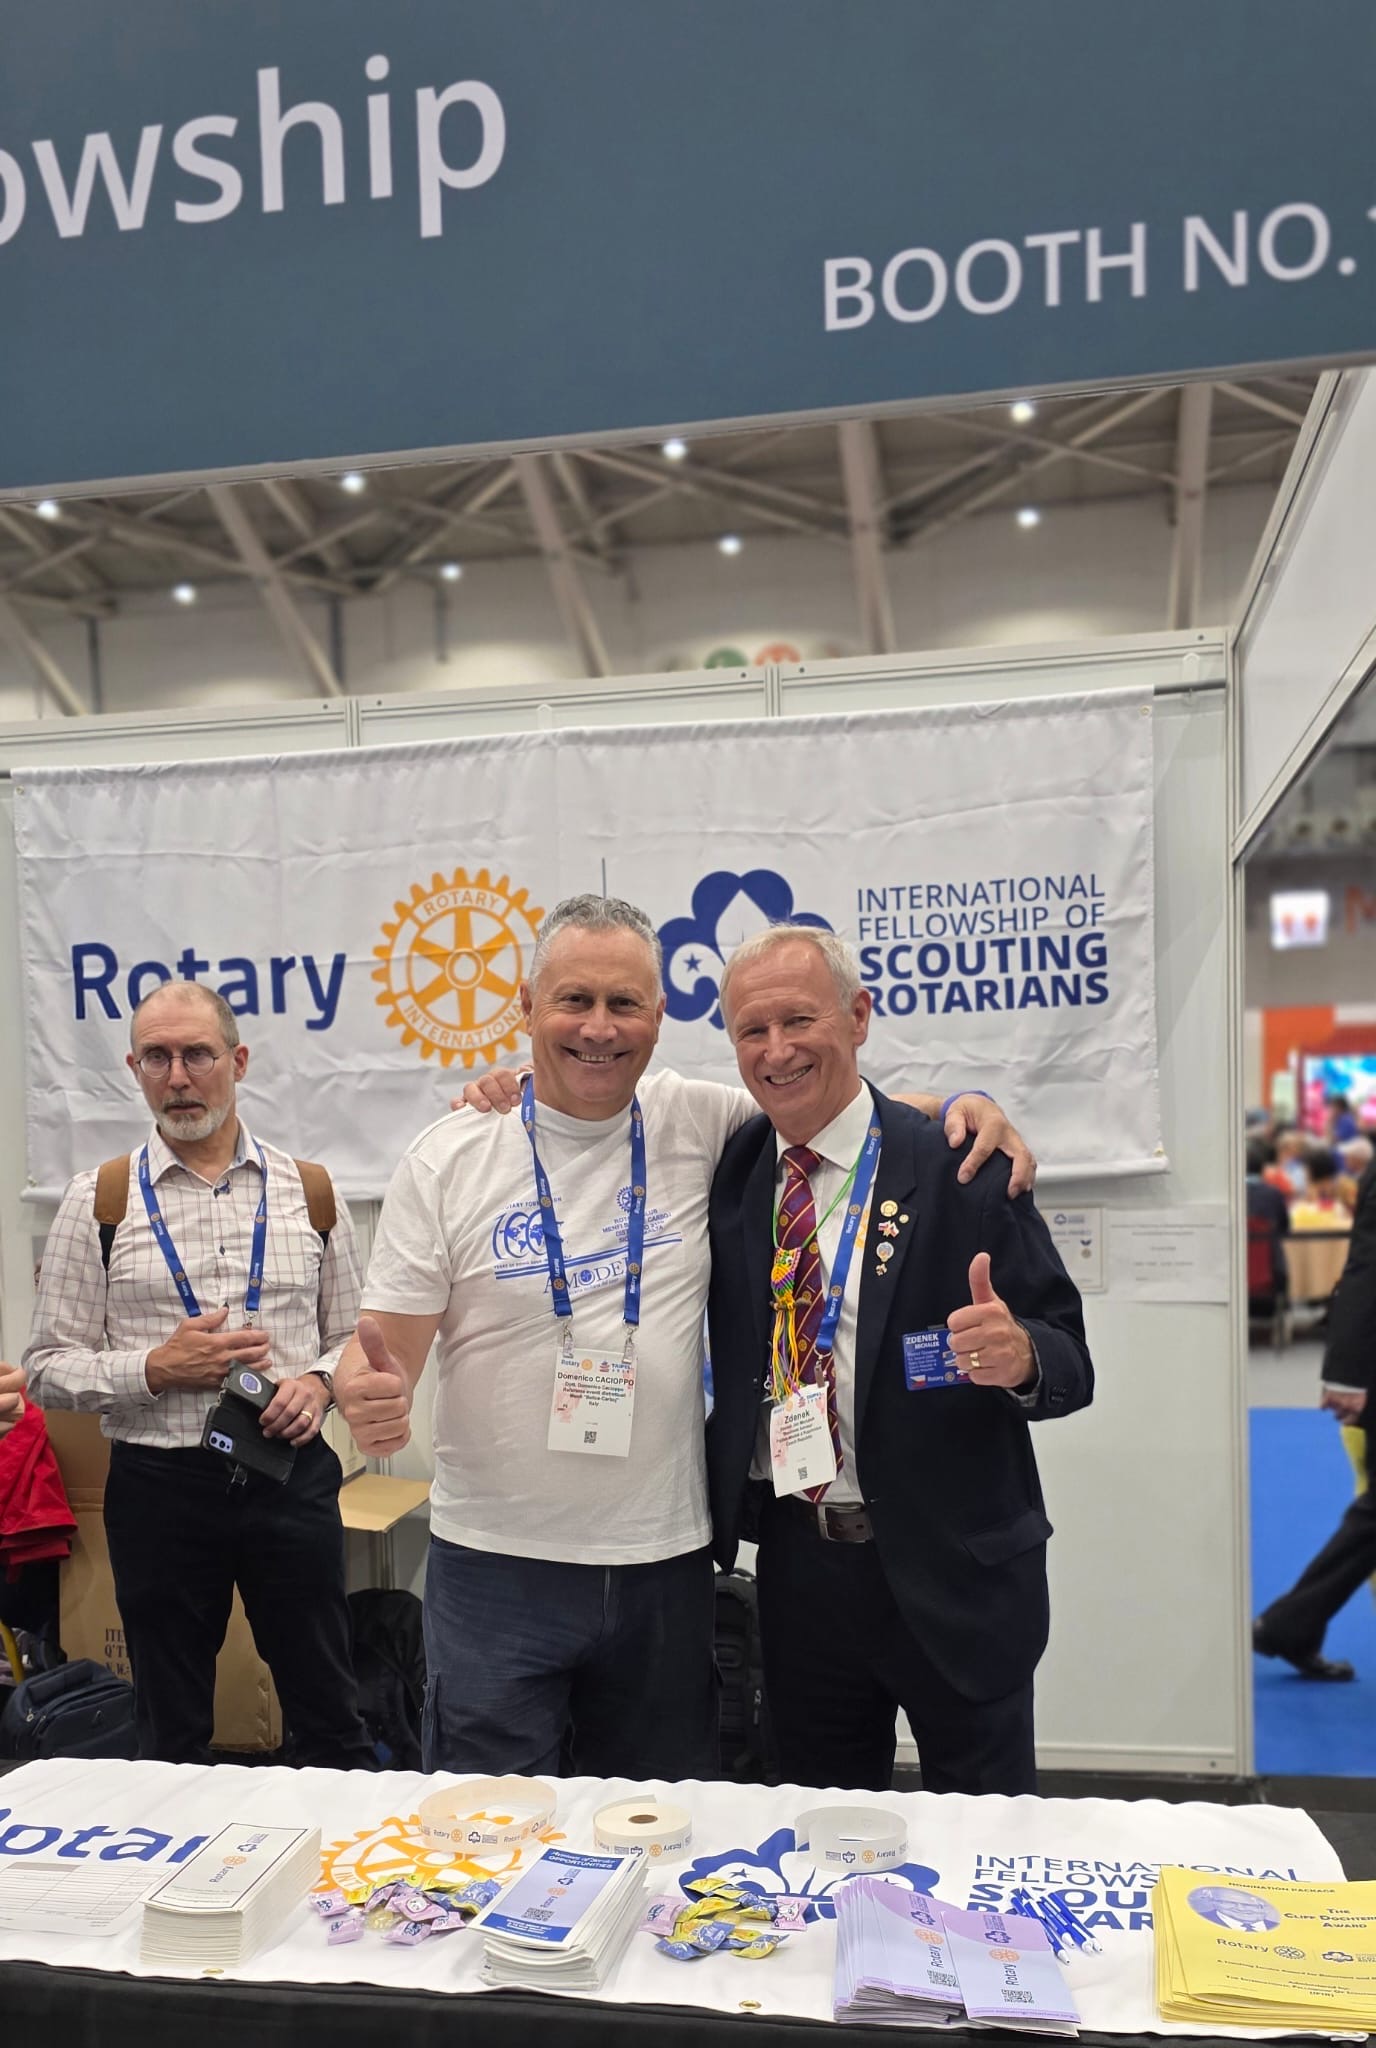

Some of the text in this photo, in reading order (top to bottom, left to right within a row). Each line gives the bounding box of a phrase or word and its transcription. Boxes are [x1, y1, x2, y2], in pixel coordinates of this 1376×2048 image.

[824, 202, 1356, 332] BOOTH NO.
[424, 890, 500, 916] ROTARY
[857, 873, 1105, 913] INTERNATIONAL
[858, 903, 1105, 941] FELLOWSHIP OF
[860, 932, 1108, 981] SCOUTING
[868, 971, 1109, 1017] ROTARIANS
[405, 1002, 524, 1048] INTERNATIONA
[905, 1333, 939, 1345] ZDENEK
[561, 1359, 580, 1368] Rotary
[557, 1372, 635, 1387] Domenico CACIOPPO
[784, 1409, 810, 1424] Zdenek
[209, 1866, 234, 1883] Rotary
[929, 1945, 945, 1968] Rotary
[1216, 1938, 1269, 1953] Rotary
[1005, 1964, 1020, 1985] Rotary
